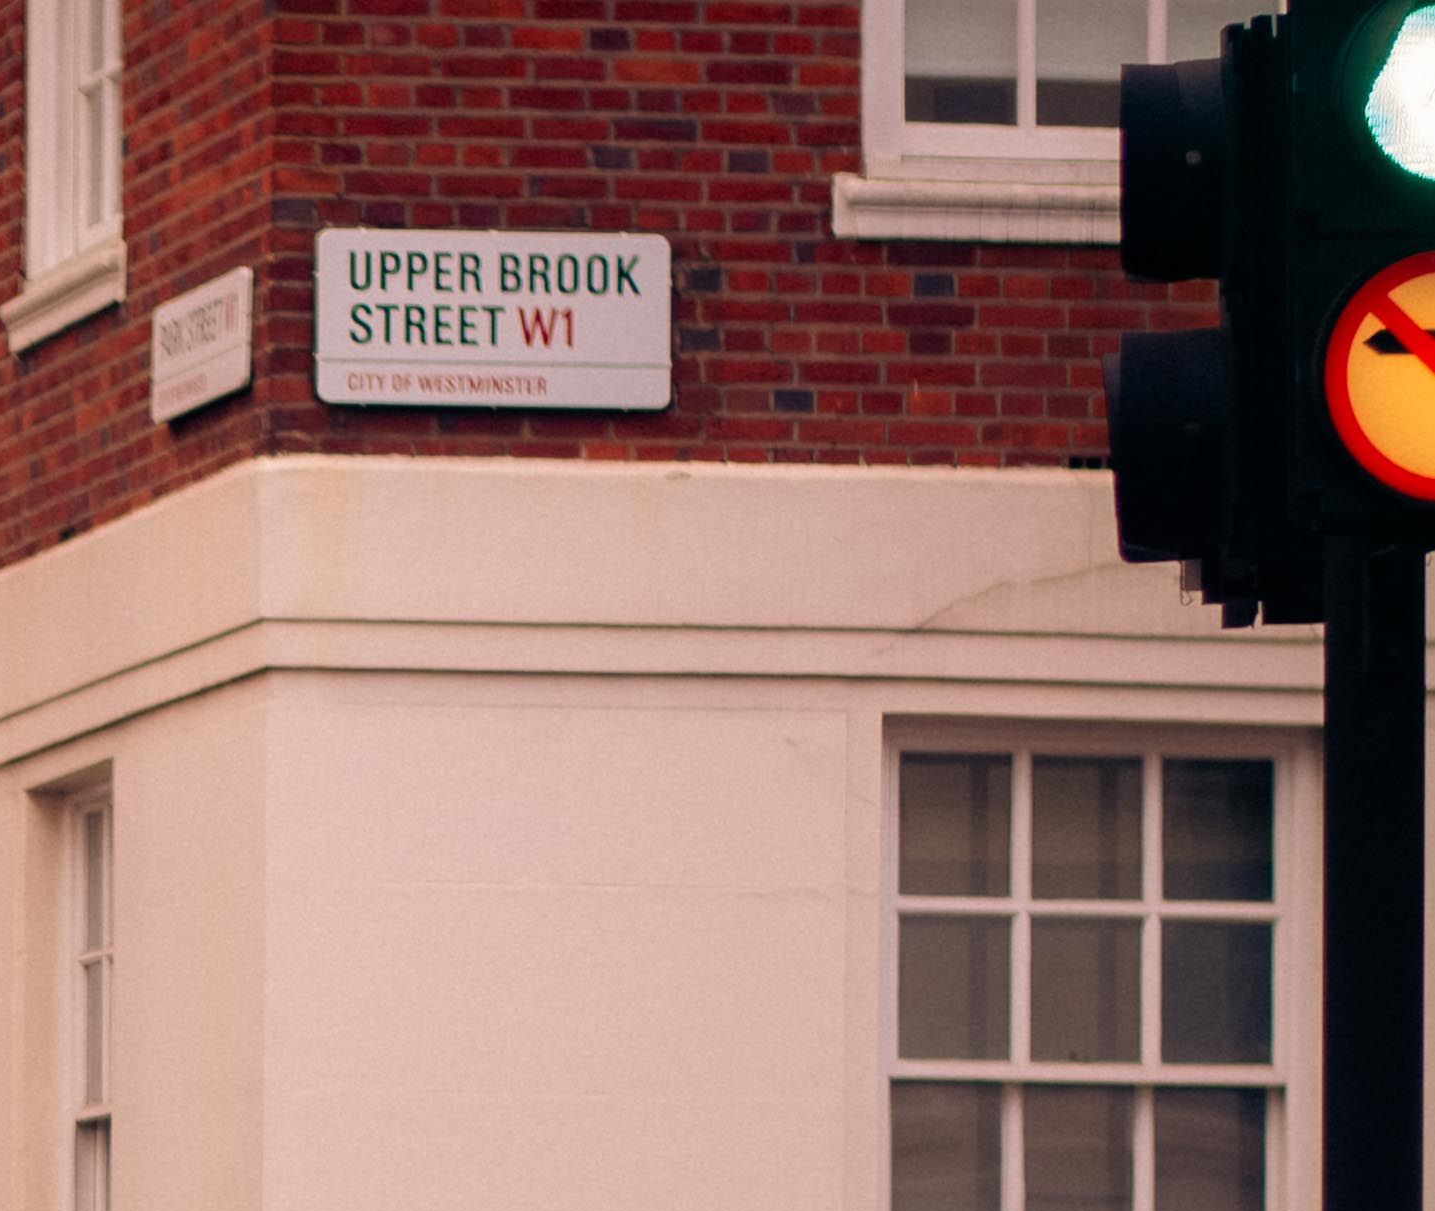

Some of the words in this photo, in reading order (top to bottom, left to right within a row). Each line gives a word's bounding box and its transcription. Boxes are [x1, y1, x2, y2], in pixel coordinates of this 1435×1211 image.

[349, 251, 483, 292] UPPER
[499, 254, 641, 295] BROOK
[349, 303, 506, 347] STREET
[518, 306, 576, 349] W1
[348, 372, 385, 392] CITY
[392, 373, 412, 393] OF
[417, 375, 548, 396] WESTMINSTER
